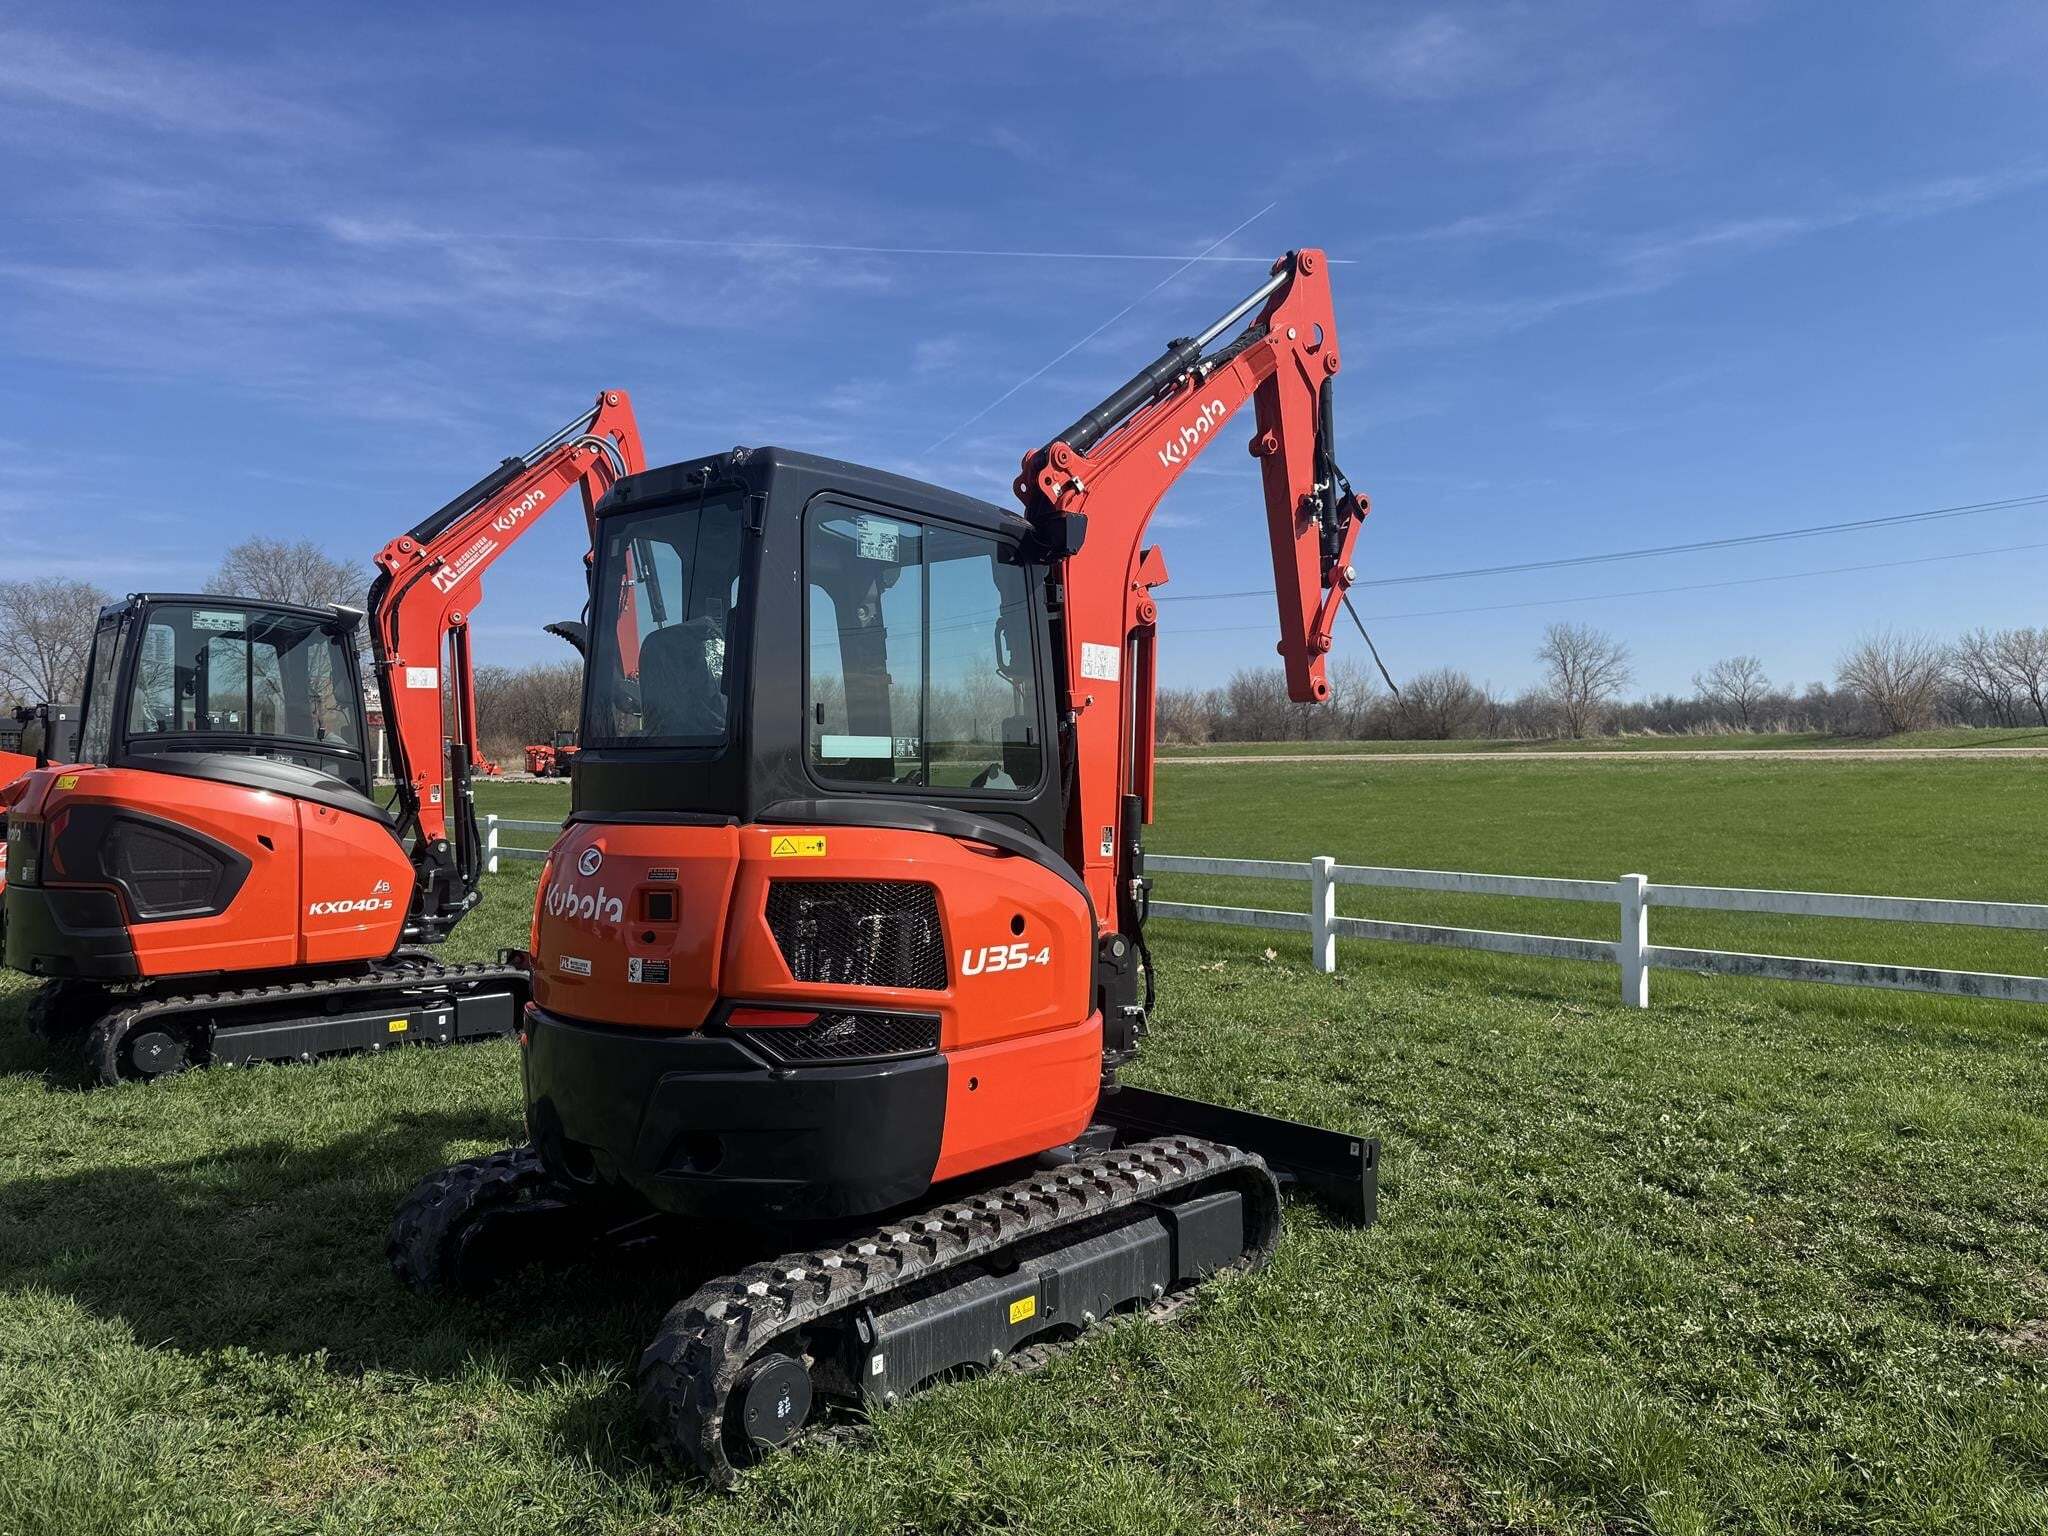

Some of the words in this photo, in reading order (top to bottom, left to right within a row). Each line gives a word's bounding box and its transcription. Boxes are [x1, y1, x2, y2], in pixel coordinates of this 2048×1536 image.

[1158, 399, 1227, 467] Kubota
[491, 489, 546, 532] Kubota
[309, 898, 393, 915] KX040-5
[545, 883, 623, 923] Kubota
[961, 942, 1050, 976] U35-4
